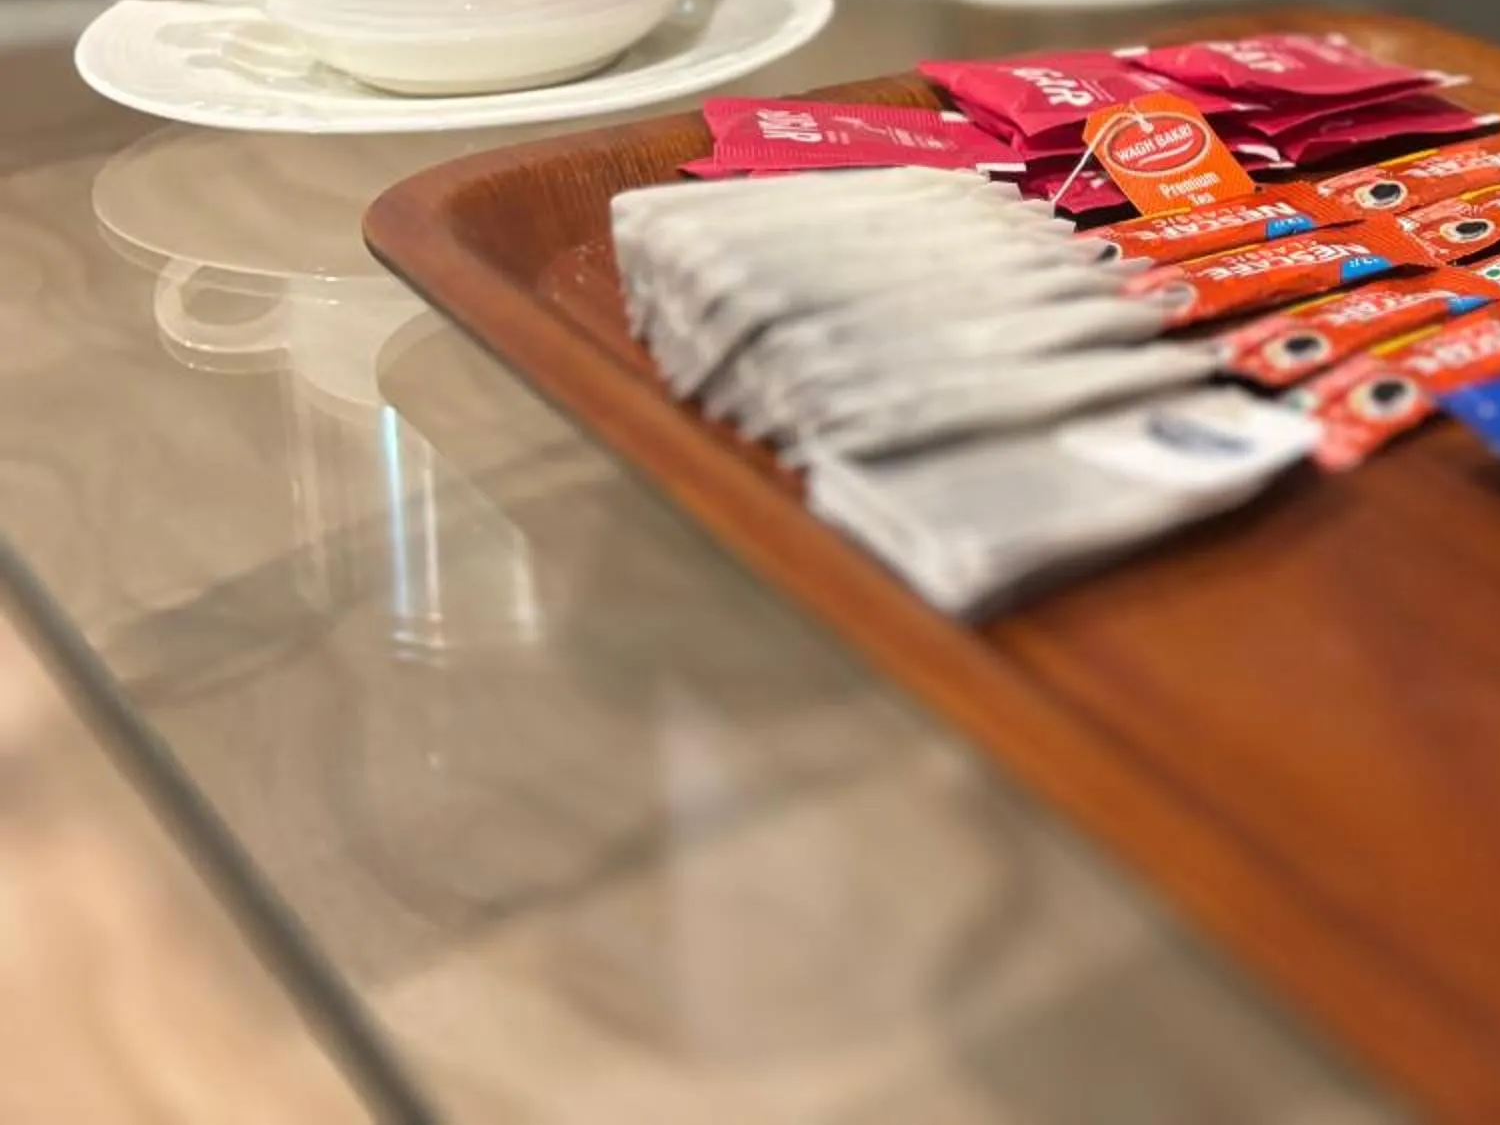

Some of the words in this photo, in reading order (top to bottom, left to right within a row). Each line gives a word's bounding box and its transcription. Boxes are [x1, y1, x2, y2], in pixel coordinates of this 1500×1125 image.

[1117, 138, 1155, 162] WAGH
[1155, 123, 1193, 149] BAKRI
[1158, 171, 1221, 200] Premium
